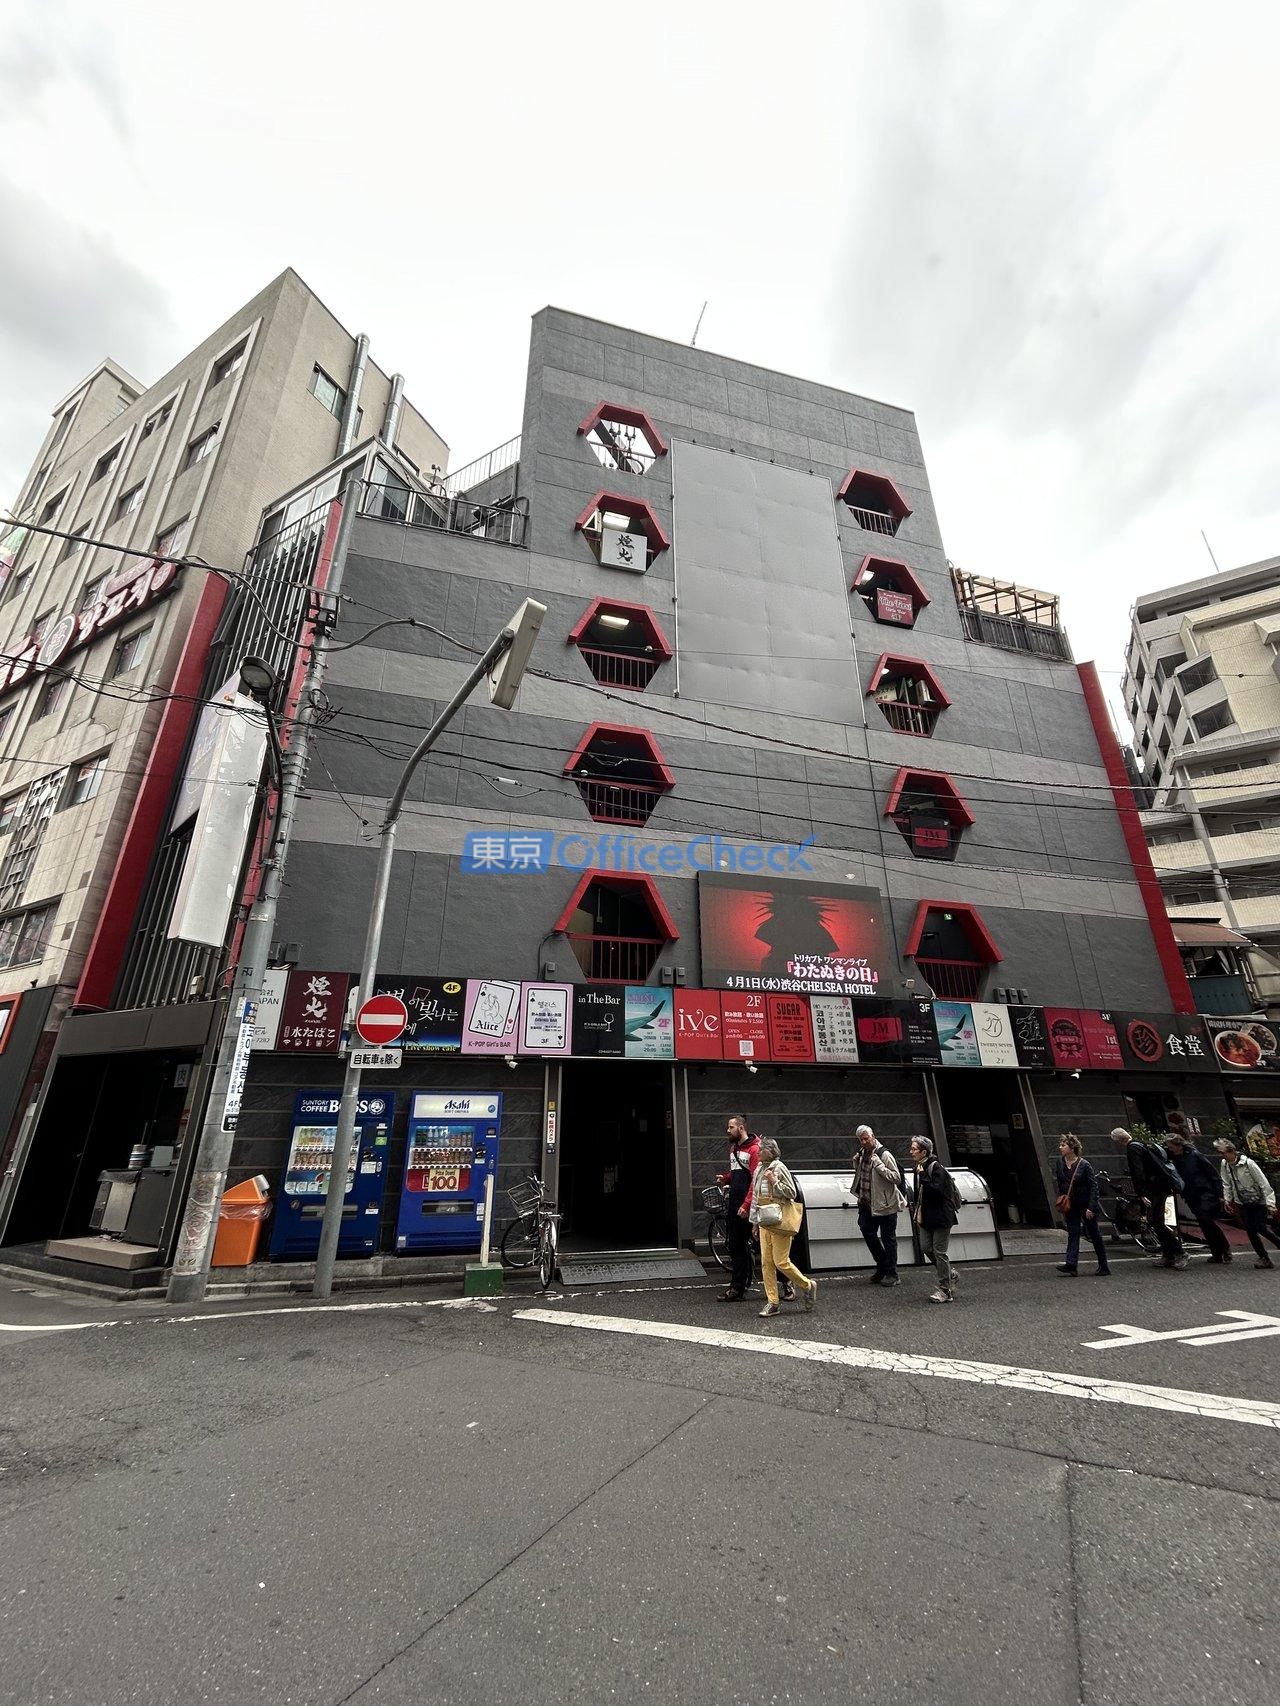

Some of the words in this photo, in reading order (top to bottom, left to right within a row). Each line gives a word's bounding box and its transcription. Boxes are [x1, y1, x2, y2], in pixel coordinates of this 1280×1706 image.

[787, 961, 879, 983] 『わたぬきの日』
[844, 983, 876, 995] HOTEL
[746, 995, 762, 1007] 2F
[777, 1002, 801, 1015] SUGAR
[919, 1003, 931, 1013] 3F
[475, 1019, 499, 1031] Alice
[658, 1018, 670, 1028] 2F
[679, 1008, 719, 1032] ive
[291, 1027, 335, 1038] 水たばこ
[1166, 1034, 1204, 1057] 食堂
[353, 1053, 399, 1065] 自転車を除く
[328, 1100, 368, 1113] BS
[444, 1100, 470, 1109] Asahi
